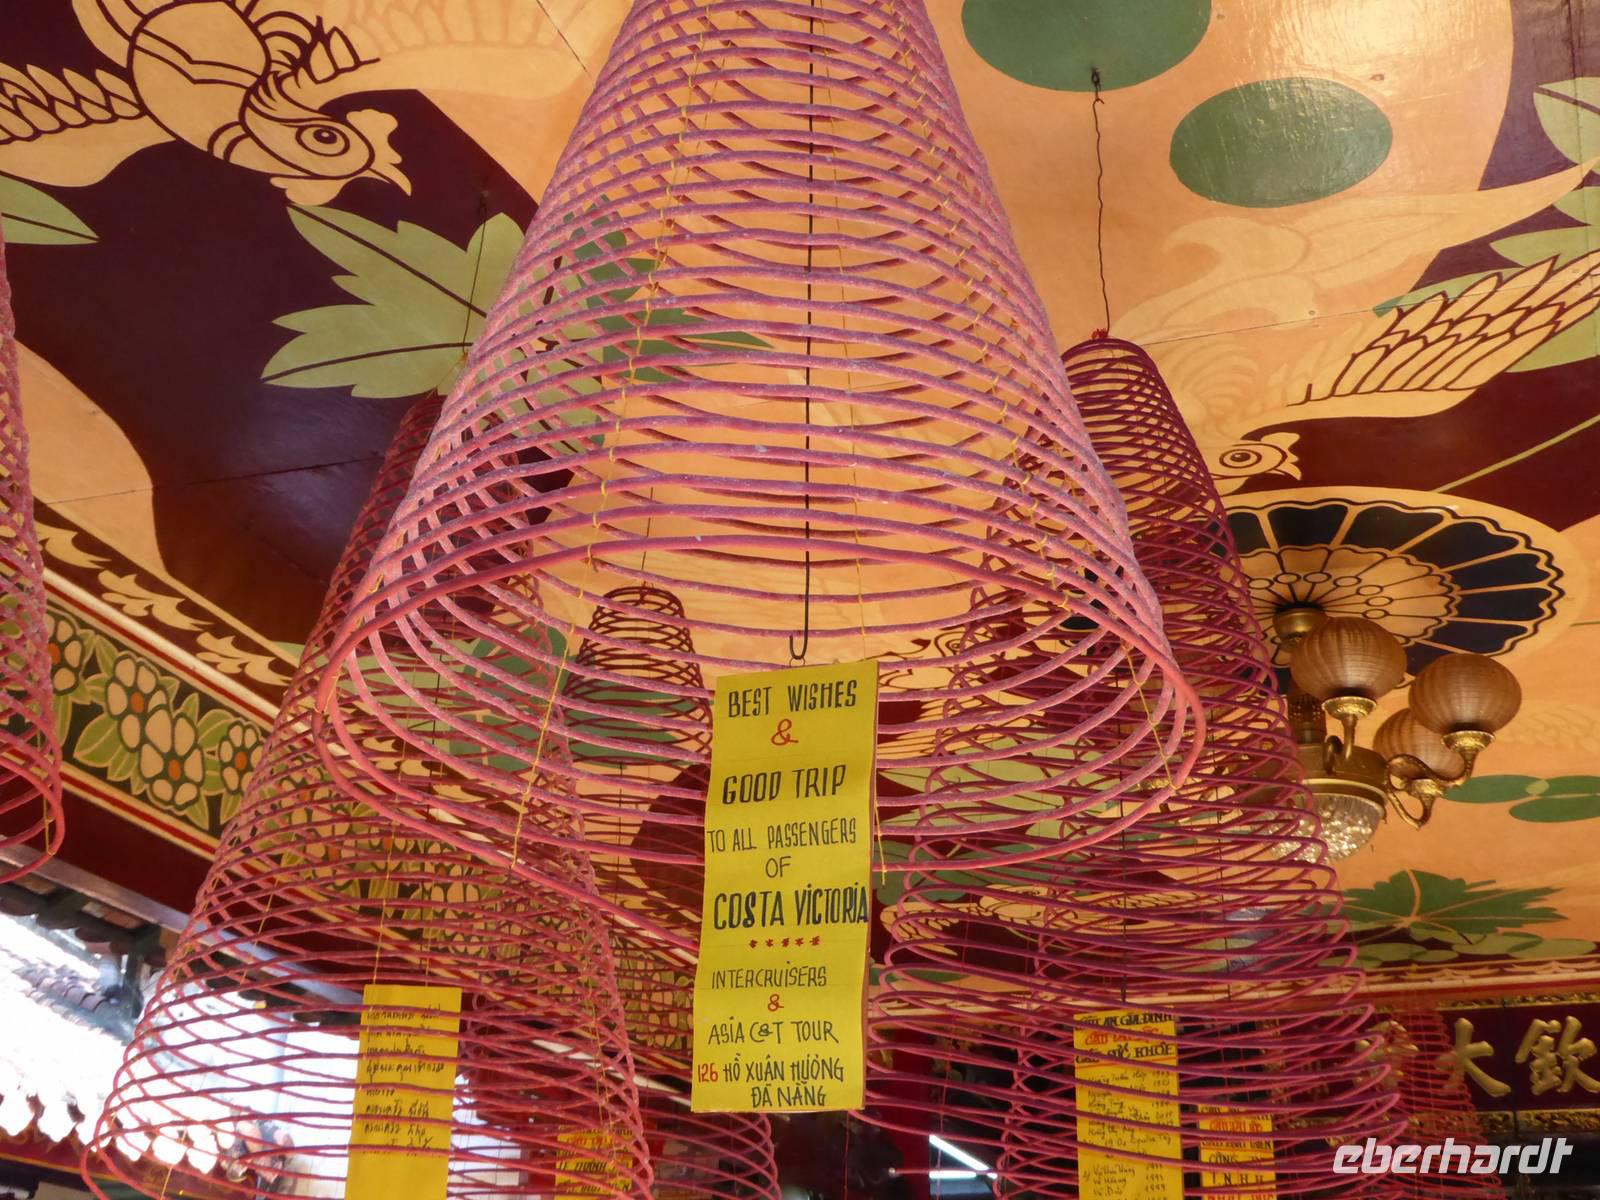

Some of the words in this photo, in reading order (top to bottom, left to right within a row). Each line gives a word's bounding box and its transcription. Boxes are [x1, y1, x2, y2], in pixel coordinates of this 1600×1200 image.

[728, 686, 772, 717] BEST
[787, 679, 857, 712] WISHES
[771, 718, 799, 746] &
[722, 771, 782, 805] GOOD
[791, 764, 847, 798] TRIP
[706, 829, 726, 852] TO
[732, 827, 757, 851] ALL
[768, 817, 857, 849] PASSENGERS
[765, 856, 792, 878] OF
[713, 890, 784, 930] COSTA
[767, 993, 785, 1012] &
[790, 1020, 840, 1044] TOUR
[697, 1062, 718, 1083] 126
